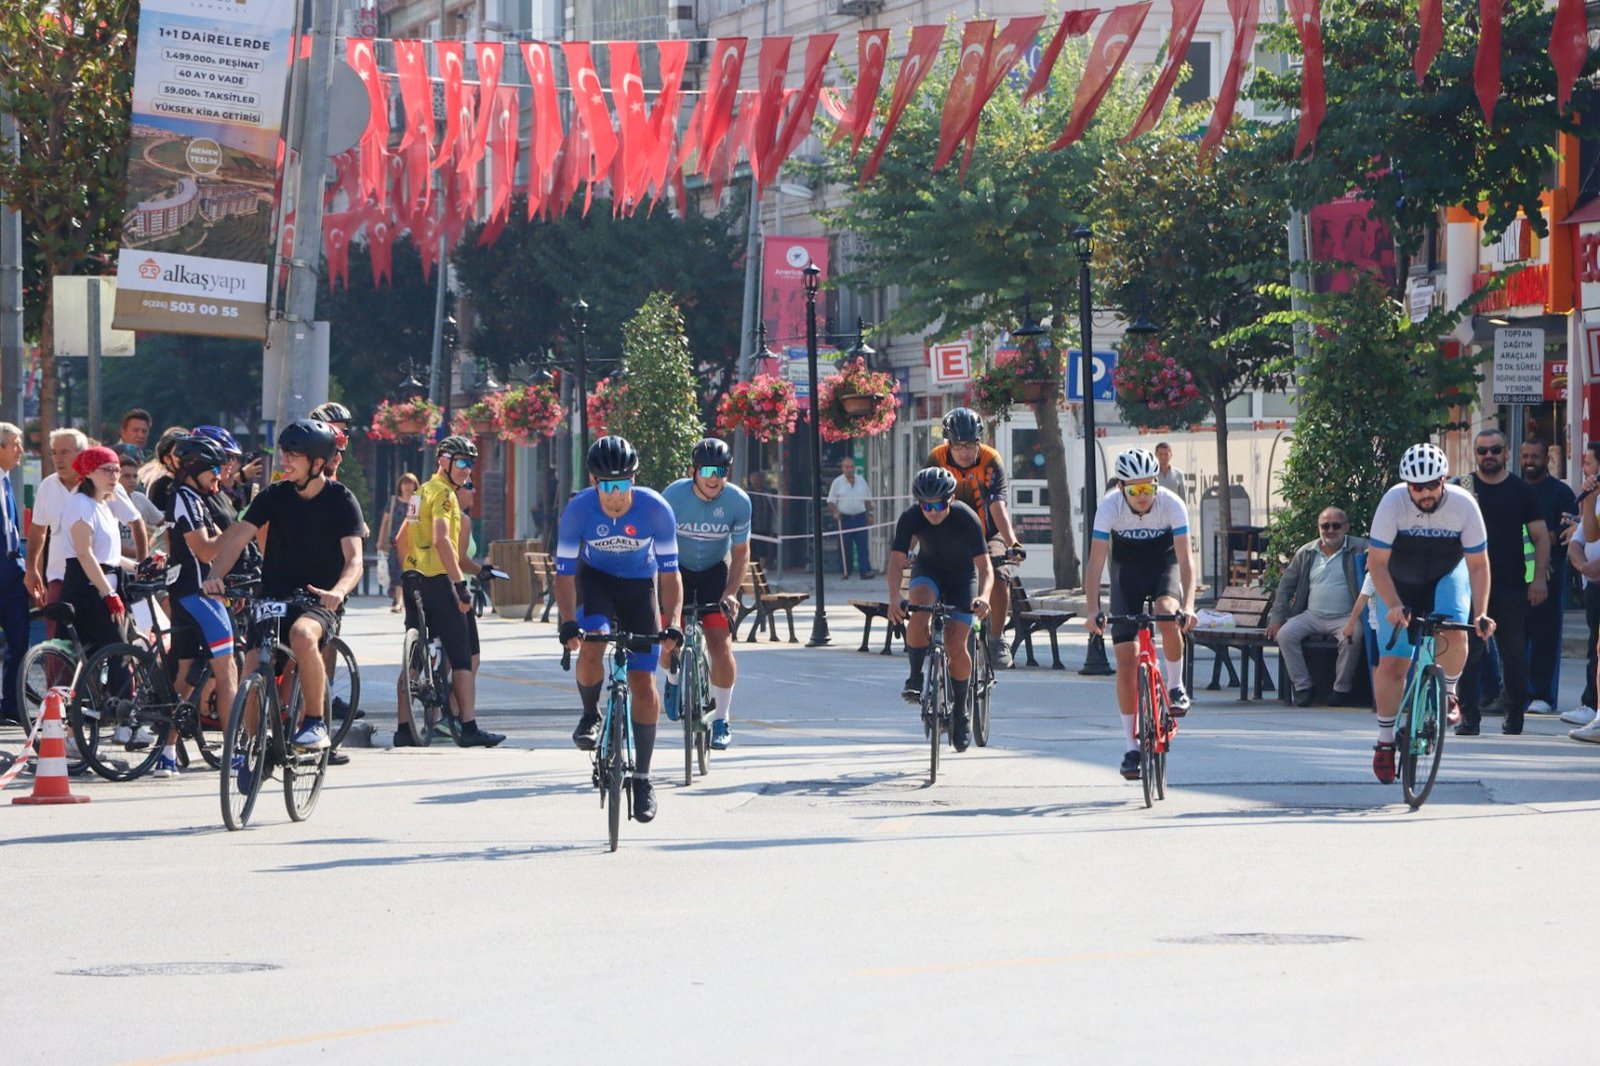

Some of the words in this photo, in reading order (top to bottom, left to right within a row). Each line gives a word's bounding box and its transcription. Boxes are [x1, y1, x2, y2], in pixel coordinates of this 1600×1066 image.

[158, 27, 178, 40] 1+1
[218, 56, 260, 71] PEŞİNAT
[178, 69, 191, 79] 40
[193, 71, 207, 81] AY
[209, 73, 215, 82] 0
[217, 74, 245, 85] VADE
[204, 88, 255, 105] TAKSİTLER
[154, 101, 194, 115] YÜKSEK
[196, 105, 220, 119] KİRA
[222, 109, 261, 124] GETİRİSİ
[190, 147, 219, 157] HEMEN
[169, 301, 196, 314] 503
[199, 303, 218, 316] 00
[221, 306, 239, 318] 55
[1504, 329, 1532, 338] TOPTAN
[1503, 340, 1533, 349] DAĞITIM
[1500, 352, 1537, 361] ARAÇLARI
[942, 350, 964, 376] E
[1516, 361, 1542, 371] SÜRELİ
[676, 522, 730, 533] YALOVA
[1408, 528, 1458, 538] YALOVA
